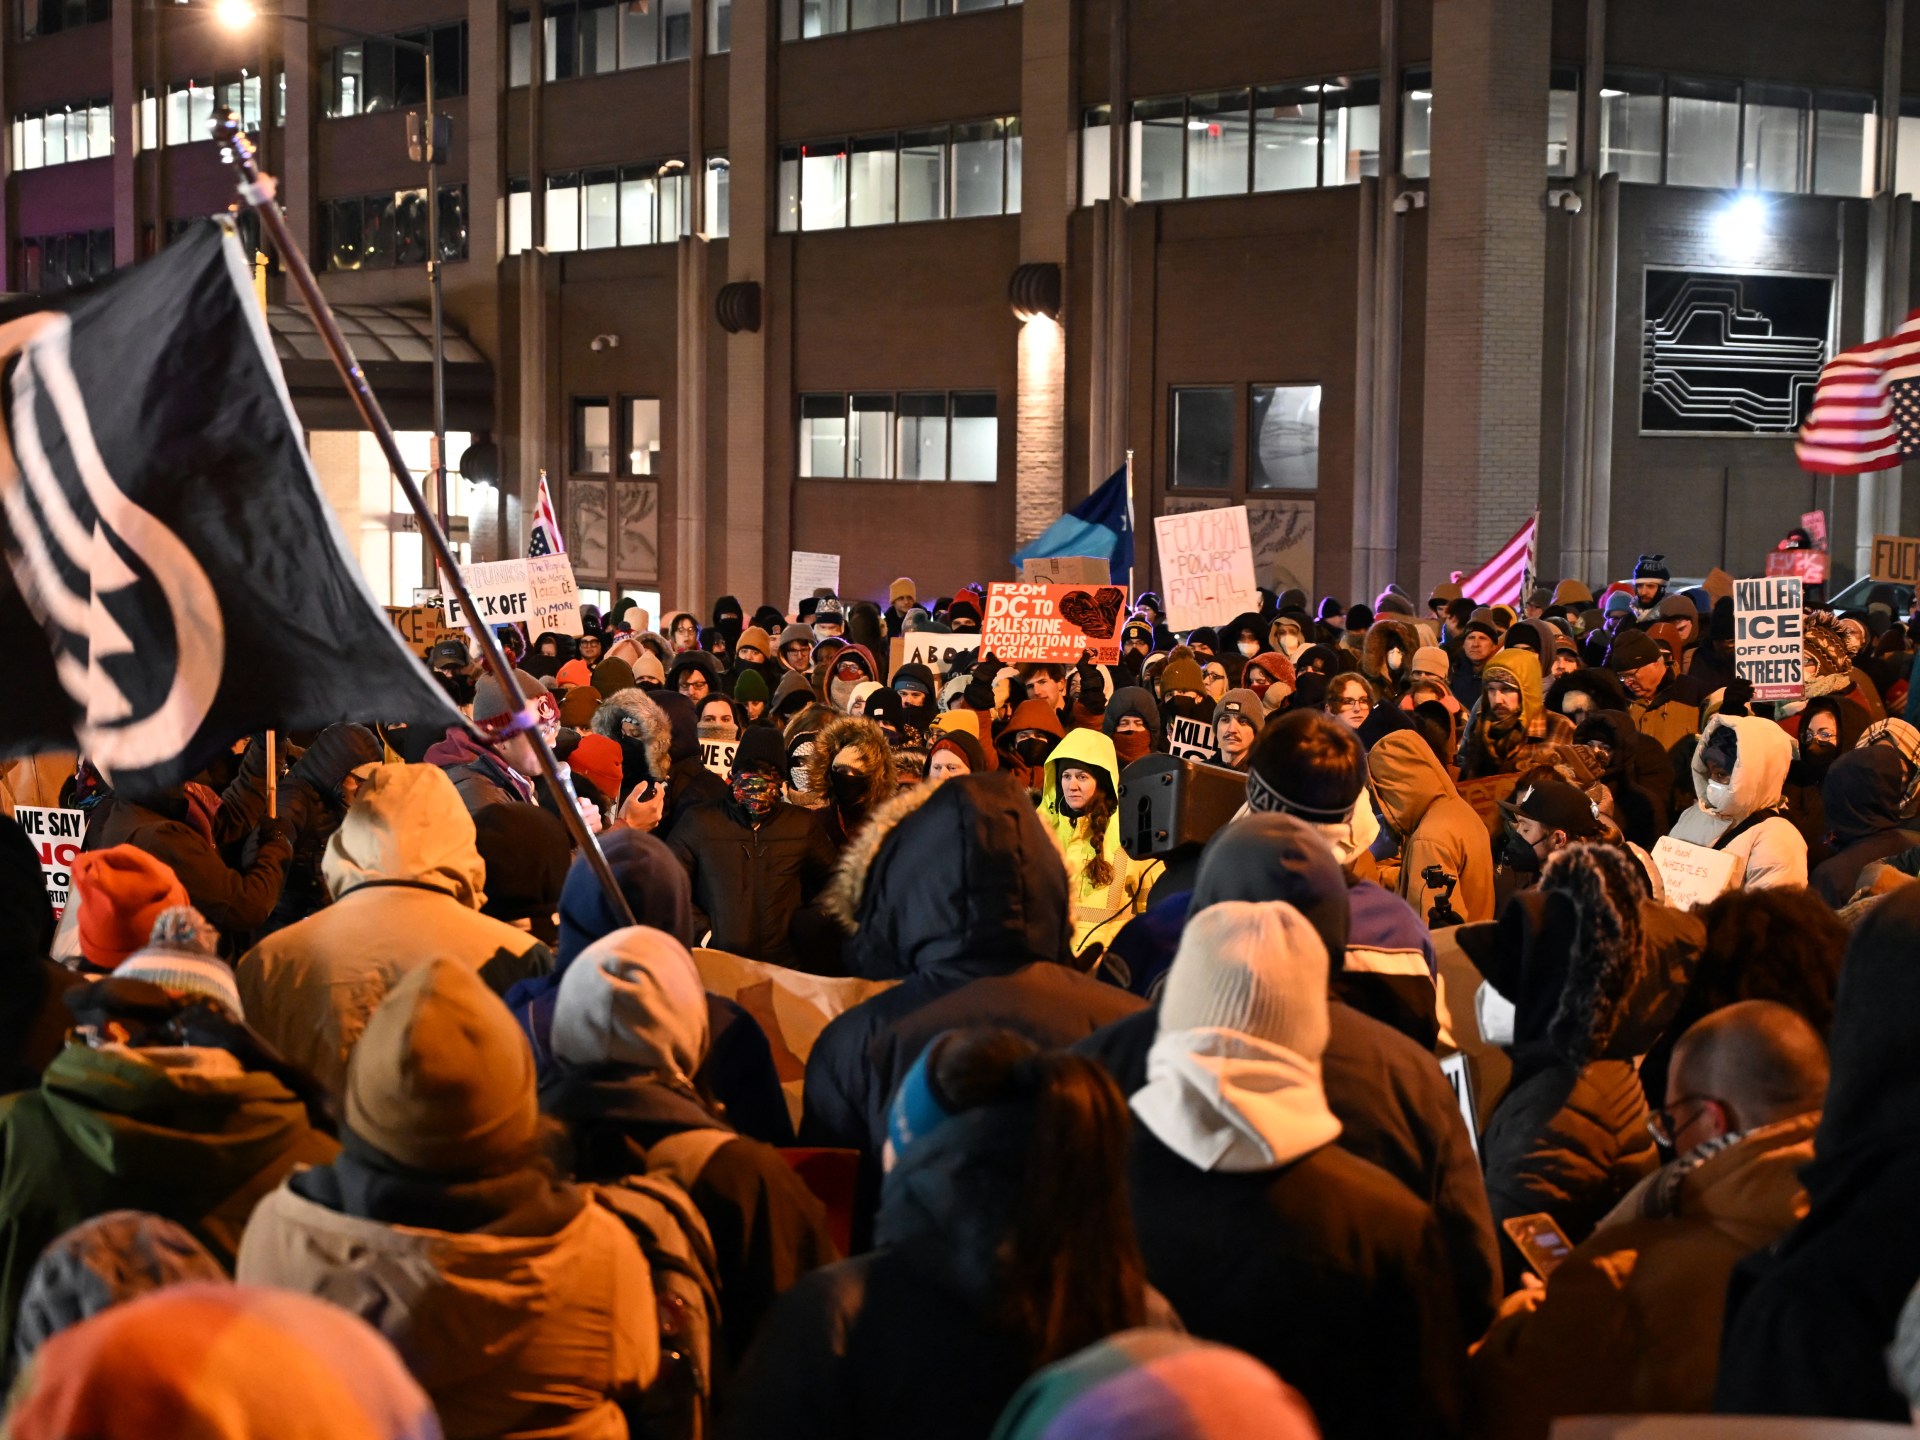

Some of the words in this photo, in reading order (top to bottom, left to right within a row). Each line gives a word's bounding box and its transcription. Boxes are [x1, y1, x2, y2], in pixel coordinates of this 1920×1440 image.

[473, 563, 526, 589] PUNKS
[991, 584, 1047, 596] FROM
[1736, 579, 1801, 612] KILLER
[449, 596, 498, 622] FK
[500, 592, 527, 615] OFF
[549, 602, 574, 613] MORE
[988, 596, 1029, 618] DC
[1032, 599, 1054, 616] TO
[986, 617, 1063, 635] PALESTINE
[1738, 615, 1800, 640] ICE
[984, 633, 1071, 648] OCCUPATION
[1073, 635, 1087, 649] IS
[1737, 645, 1766, 656] OFF
[1768, 644, 1800, 655] OUR
[911, 645, 968, 664] ABO
[996, 646, 1049, 660] CRIME
[1736, 659, 1801, 684] STREETS
[16, 810, 45, 835] WE
[48, 812, 81, 837] SAY
[37, 842, 82, 868] NO
[1663, 858, 1708, 878] WHISTLES
[41, 872, 70, 887] TO
